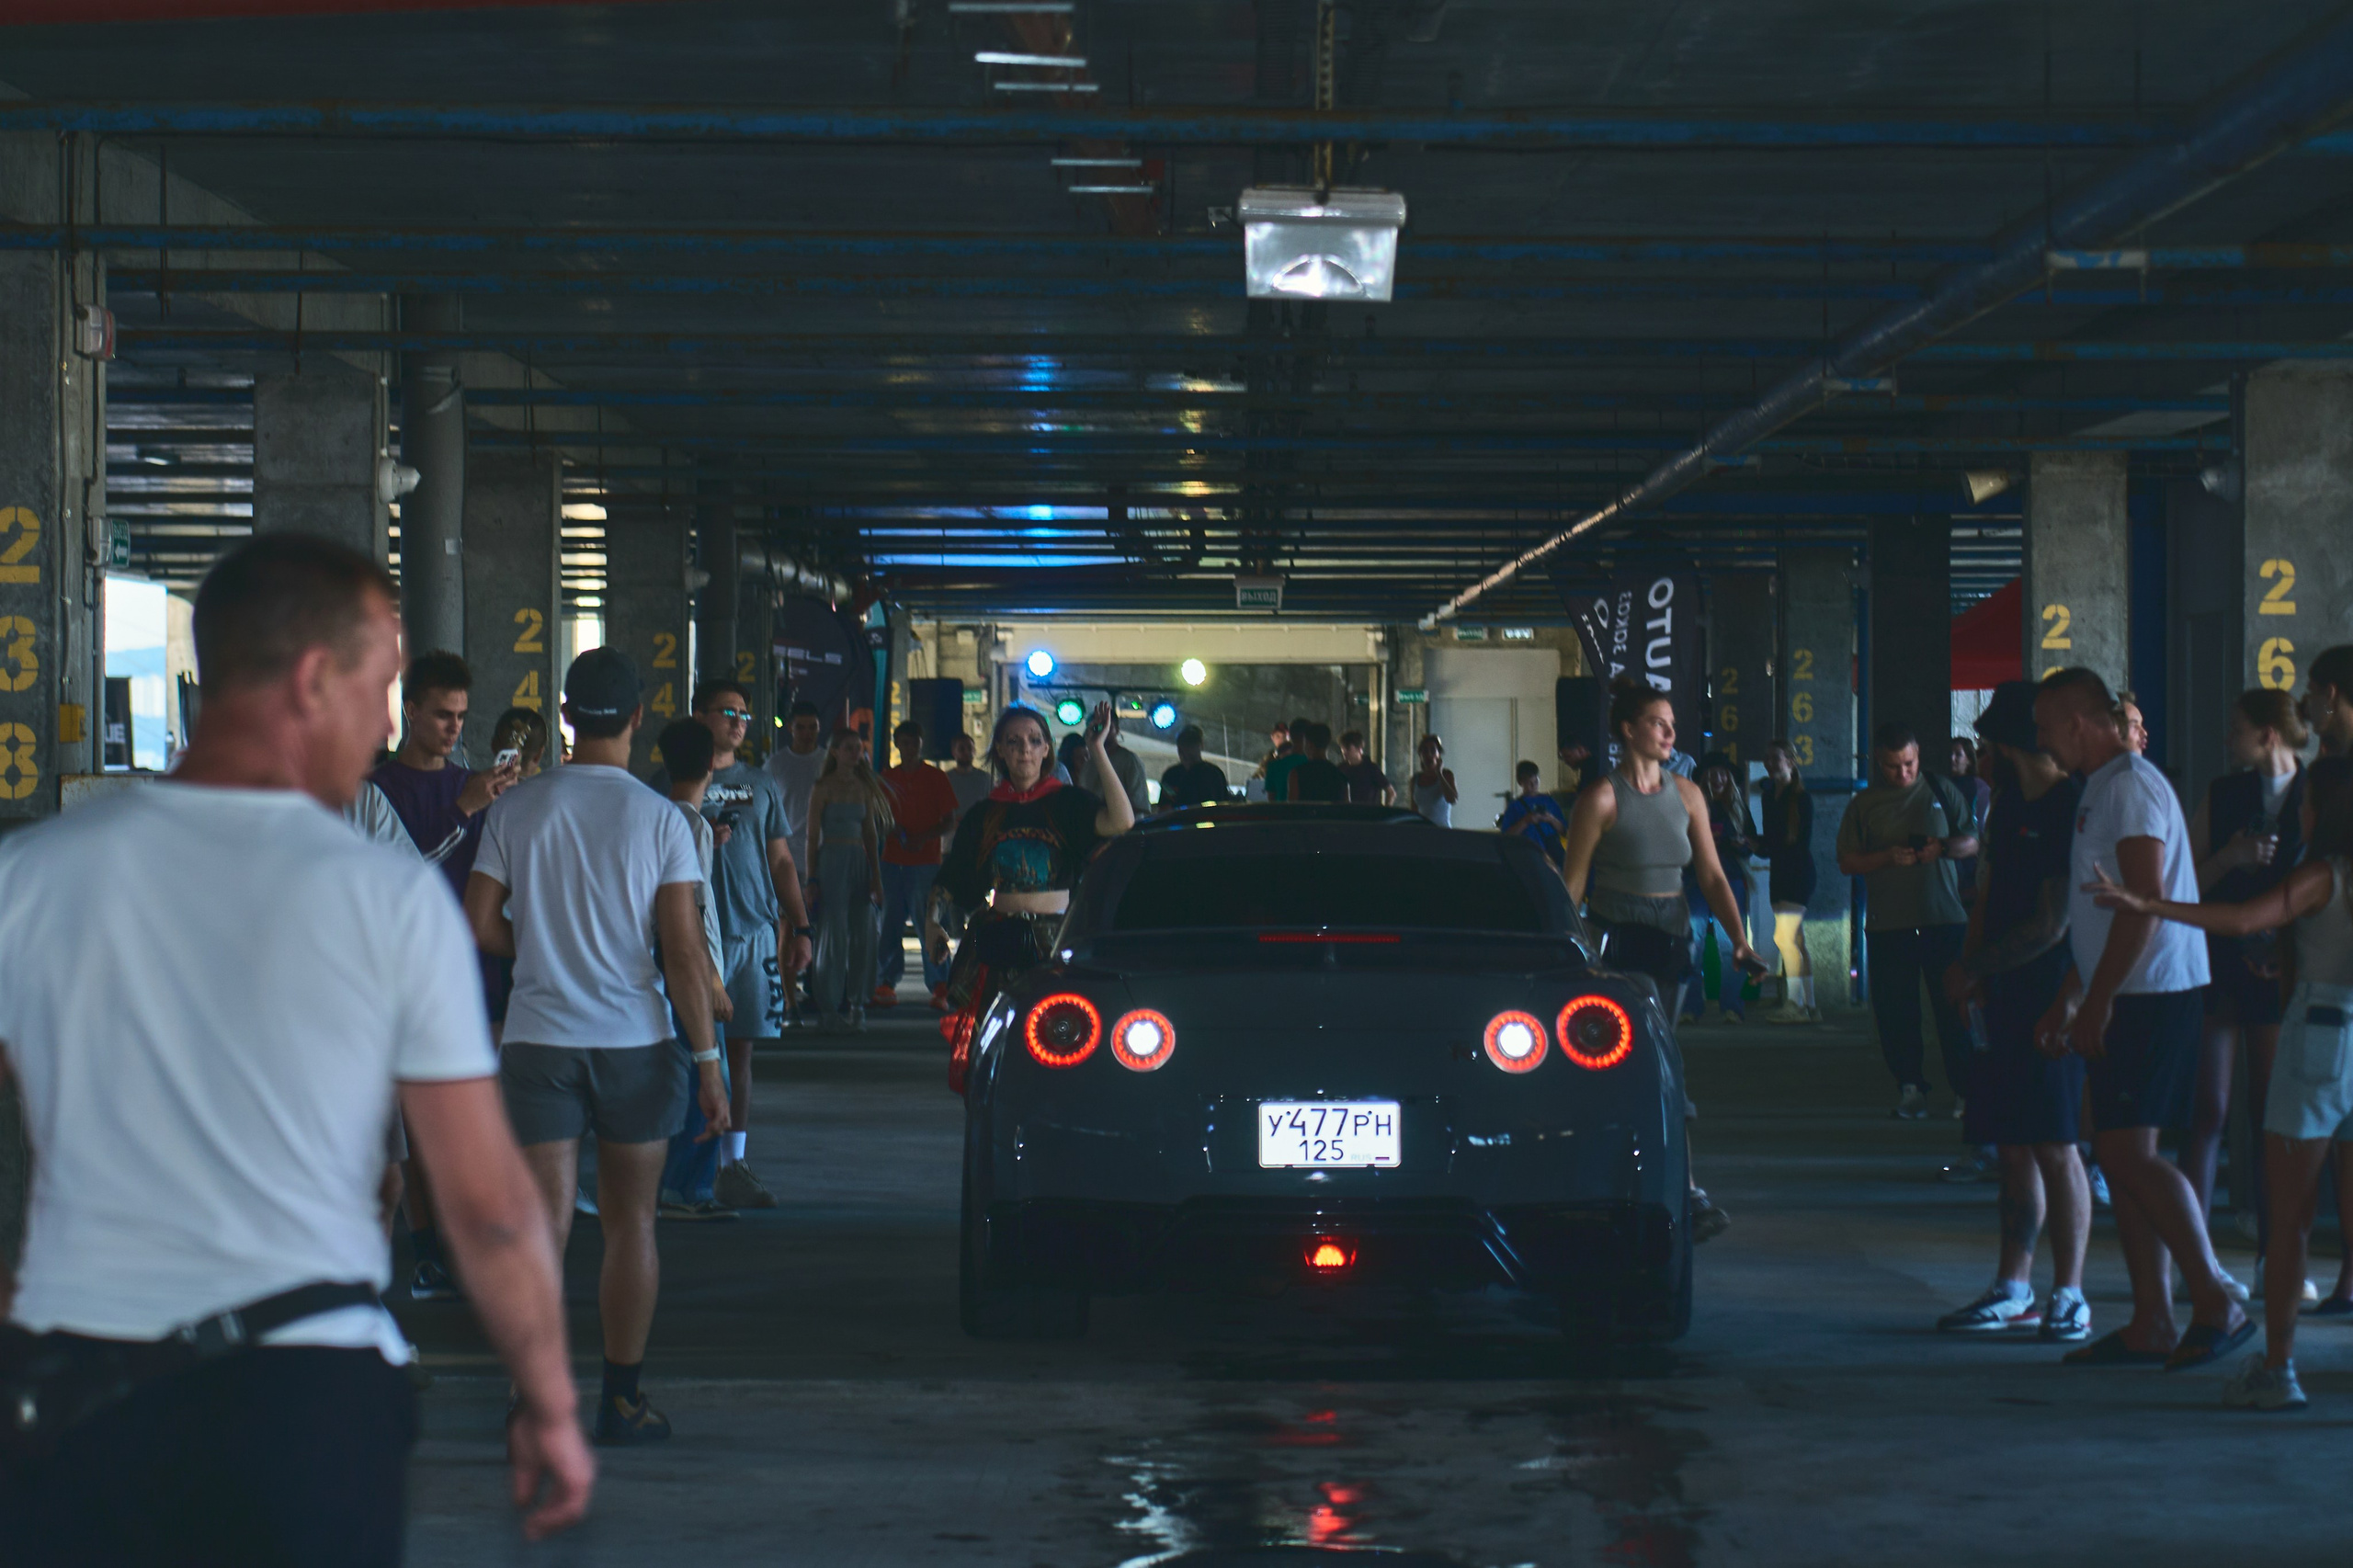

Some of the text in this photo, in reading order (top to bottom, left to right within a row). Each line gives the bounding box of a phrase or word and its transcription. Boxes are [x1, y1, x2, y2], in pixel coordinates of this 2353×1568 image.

[0, 506, 40, 800] 238
[1791, 648, 1814, 767] 263
[1267, 1108, 1392, 1137] У477РН
[1299, 1139, 1372, 1162] 125 RUS
